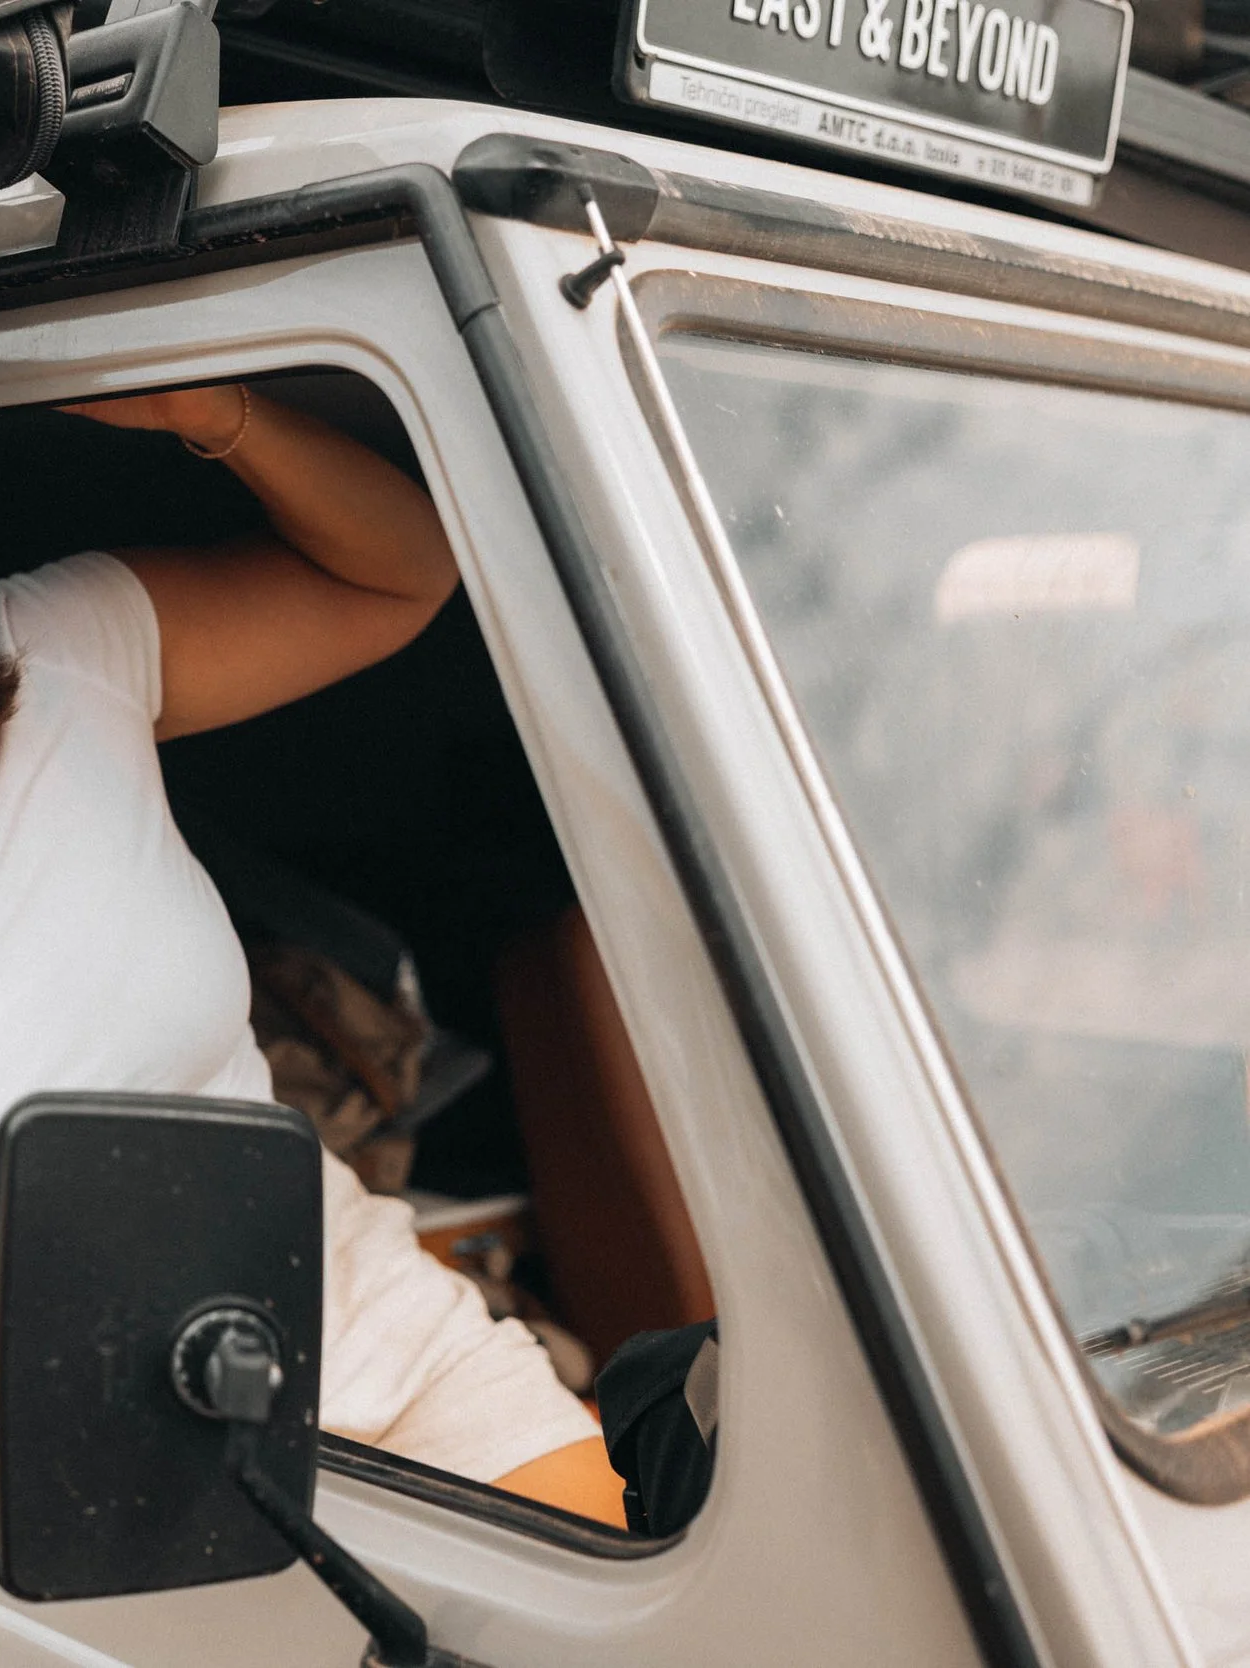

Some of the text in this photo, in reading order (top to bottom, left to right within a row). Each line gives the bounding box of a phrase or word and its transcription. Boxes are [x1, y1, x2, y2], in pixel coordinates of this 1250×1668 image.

[859, 0, 893, 62] &
[900, 0, 1059, 105] BEYOND
[818, 111, 867, 144] AMTC
